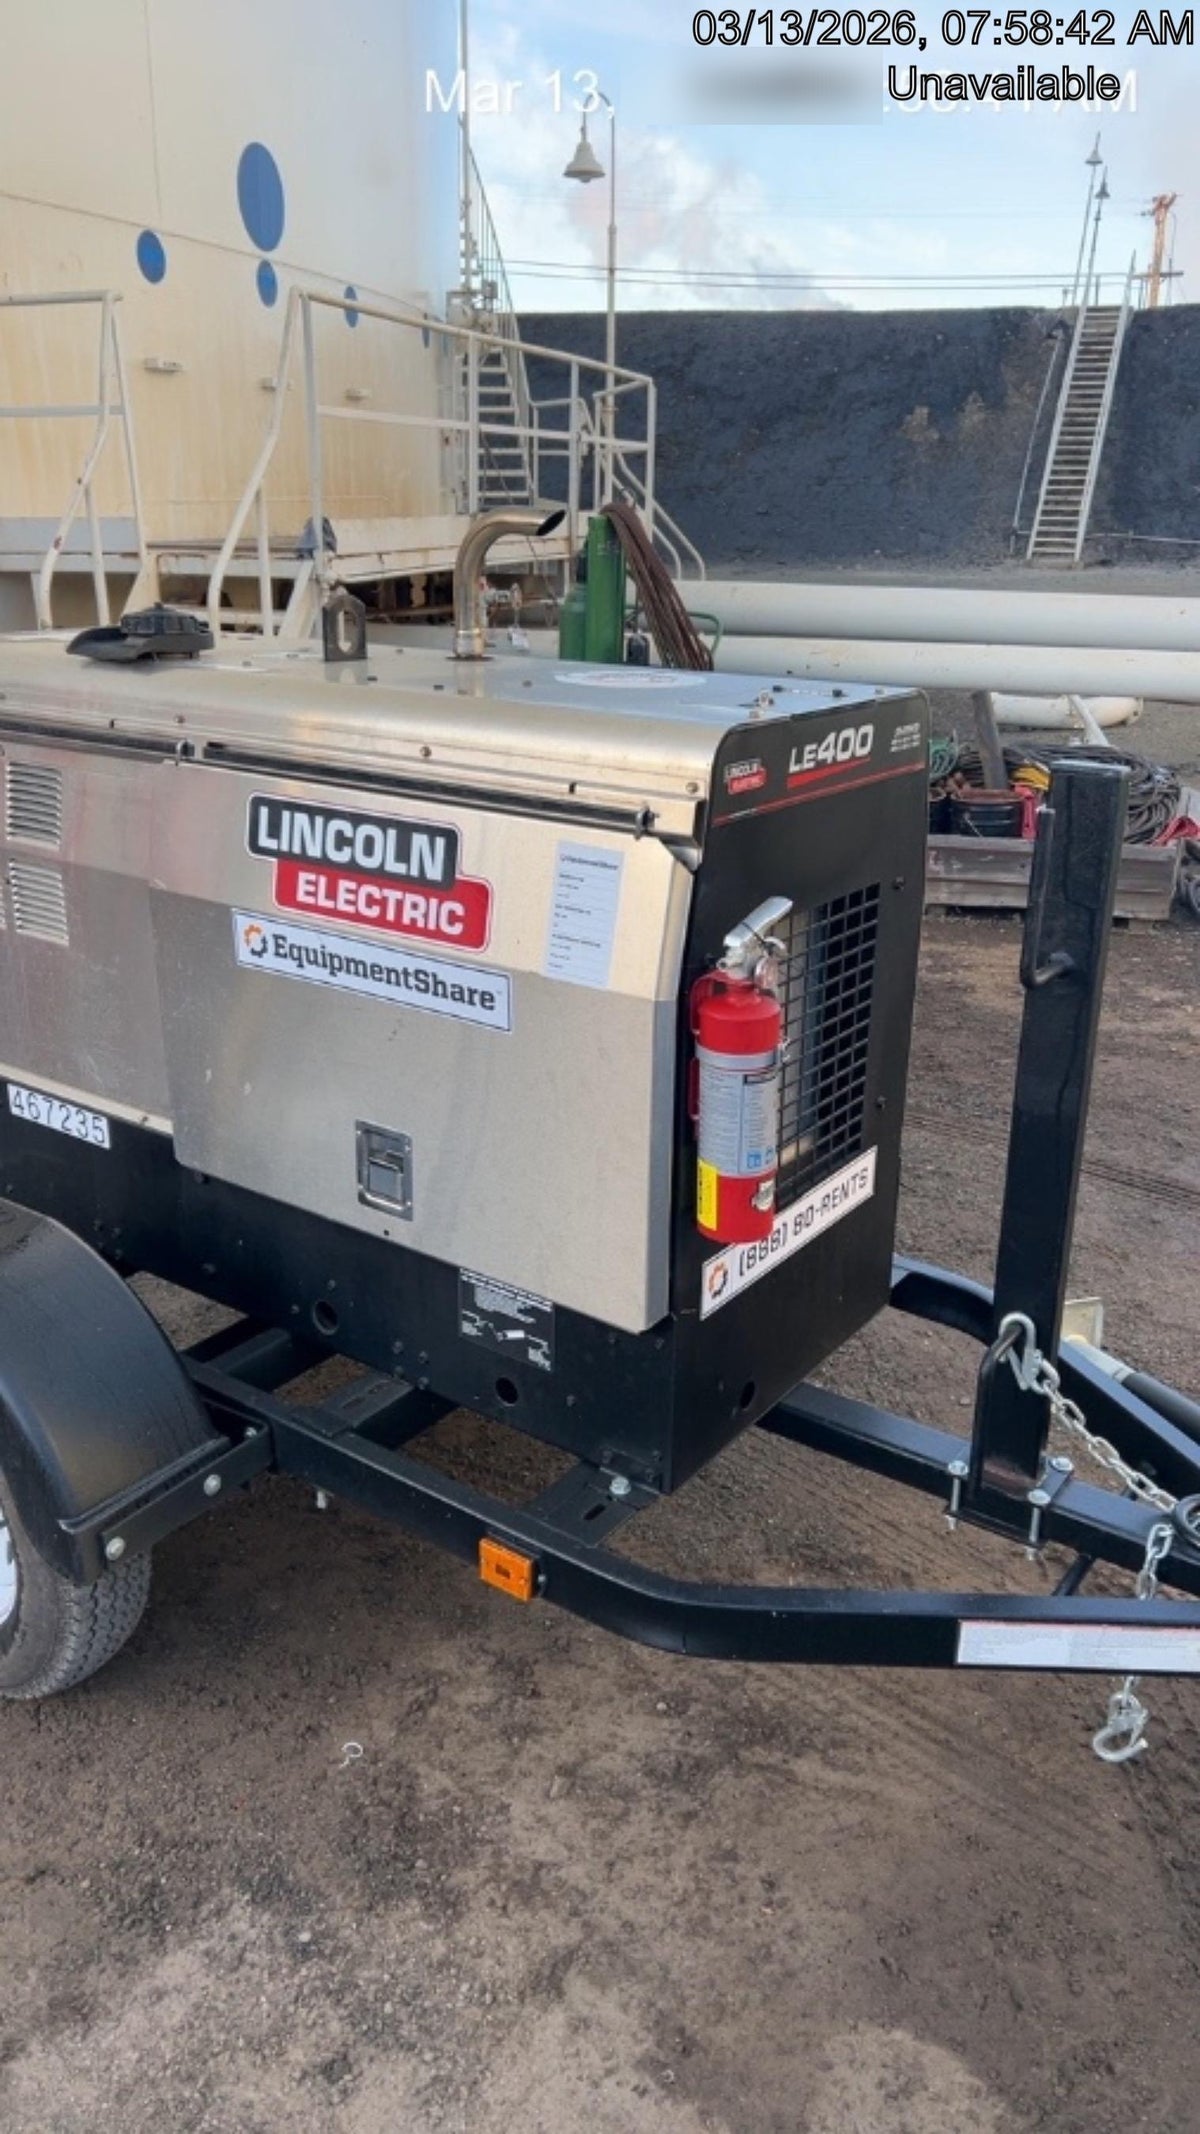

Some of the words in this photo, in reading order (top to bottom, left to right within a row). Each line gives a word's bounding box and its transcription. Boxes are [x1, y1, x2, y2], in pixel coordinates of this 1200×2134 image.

[789, 724, 874, 773] LE400
[257, 806, 446, 882] LINCOLN
[296, 872, 465, 936] ELECTRIC
[272, 934, 495, 1011] EquipmentShare
[14, 1090, 105, 1143] 467235
